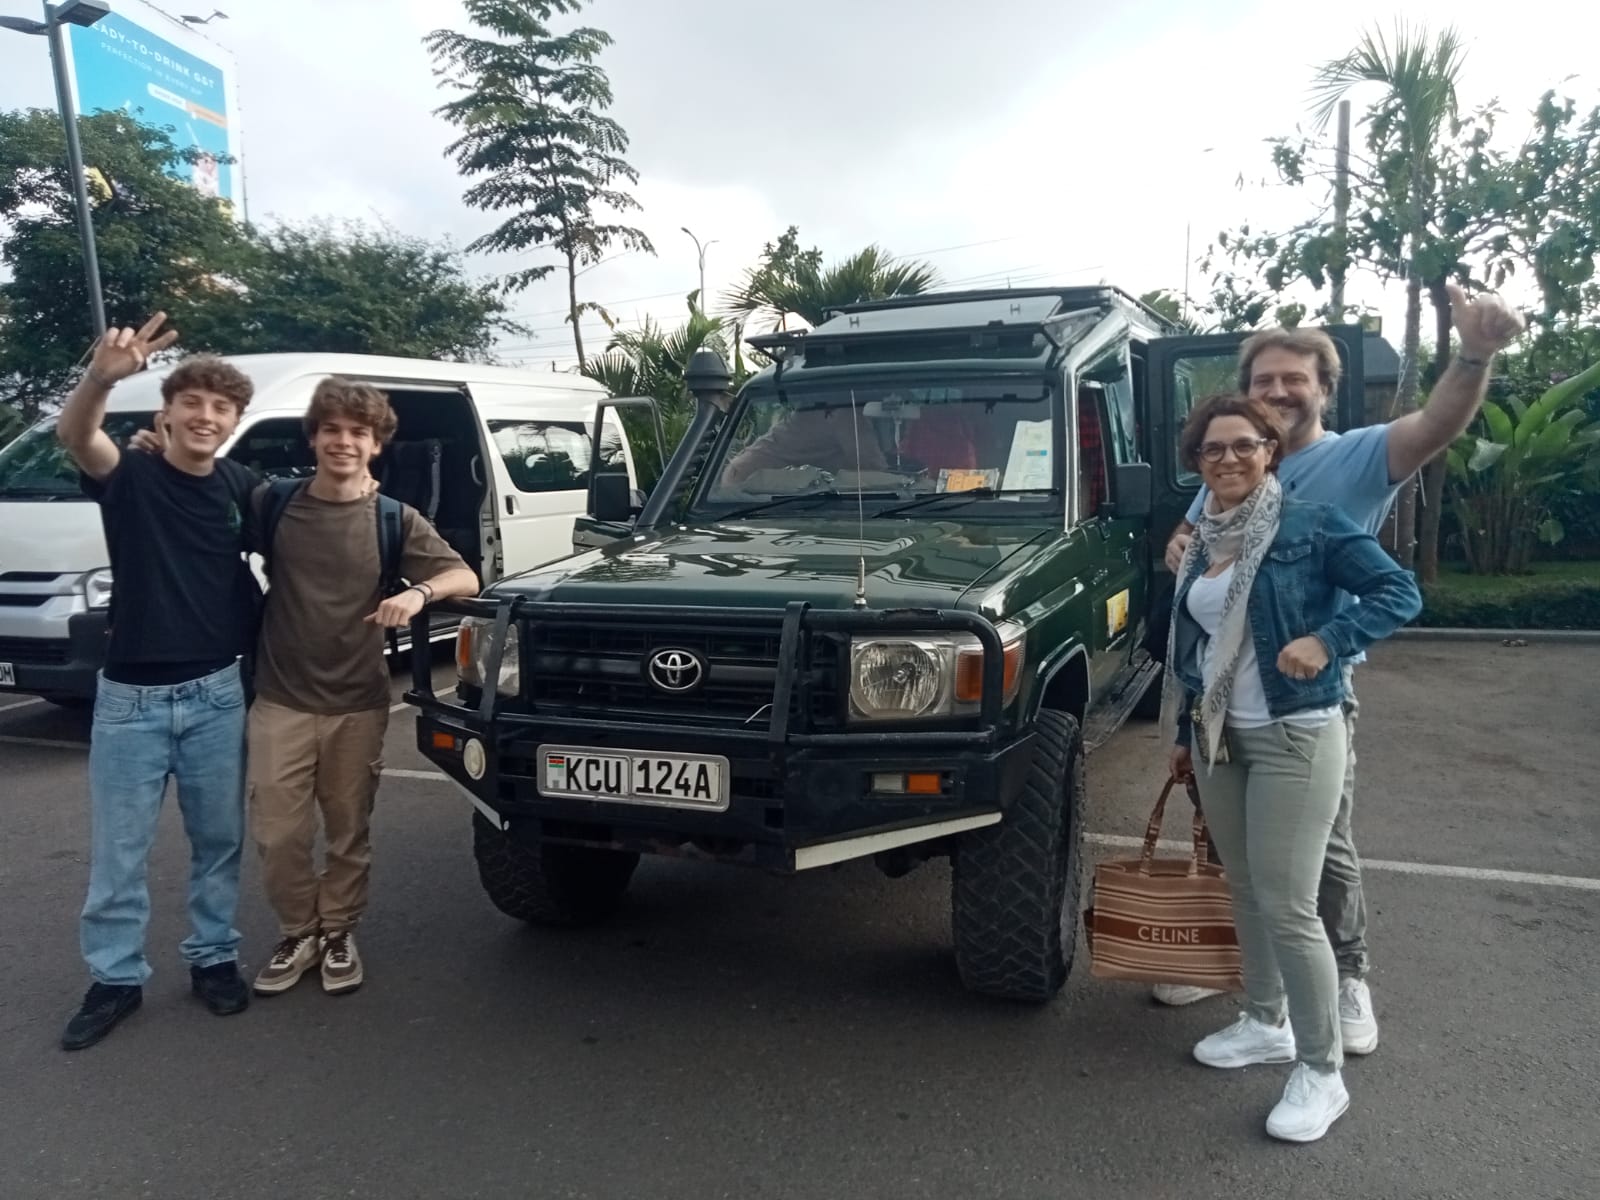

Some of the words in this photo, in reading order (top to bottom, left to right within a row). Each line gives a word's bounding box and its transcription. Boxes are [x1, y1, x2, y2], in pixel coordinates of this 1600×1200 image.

[91, 21, 190, 76] EADY-TO-DRINK
[566, 757, 621, 794] KCU
[636, 759, 711, 799] 124A
[1138, 925, 1200, 943] CELINE
